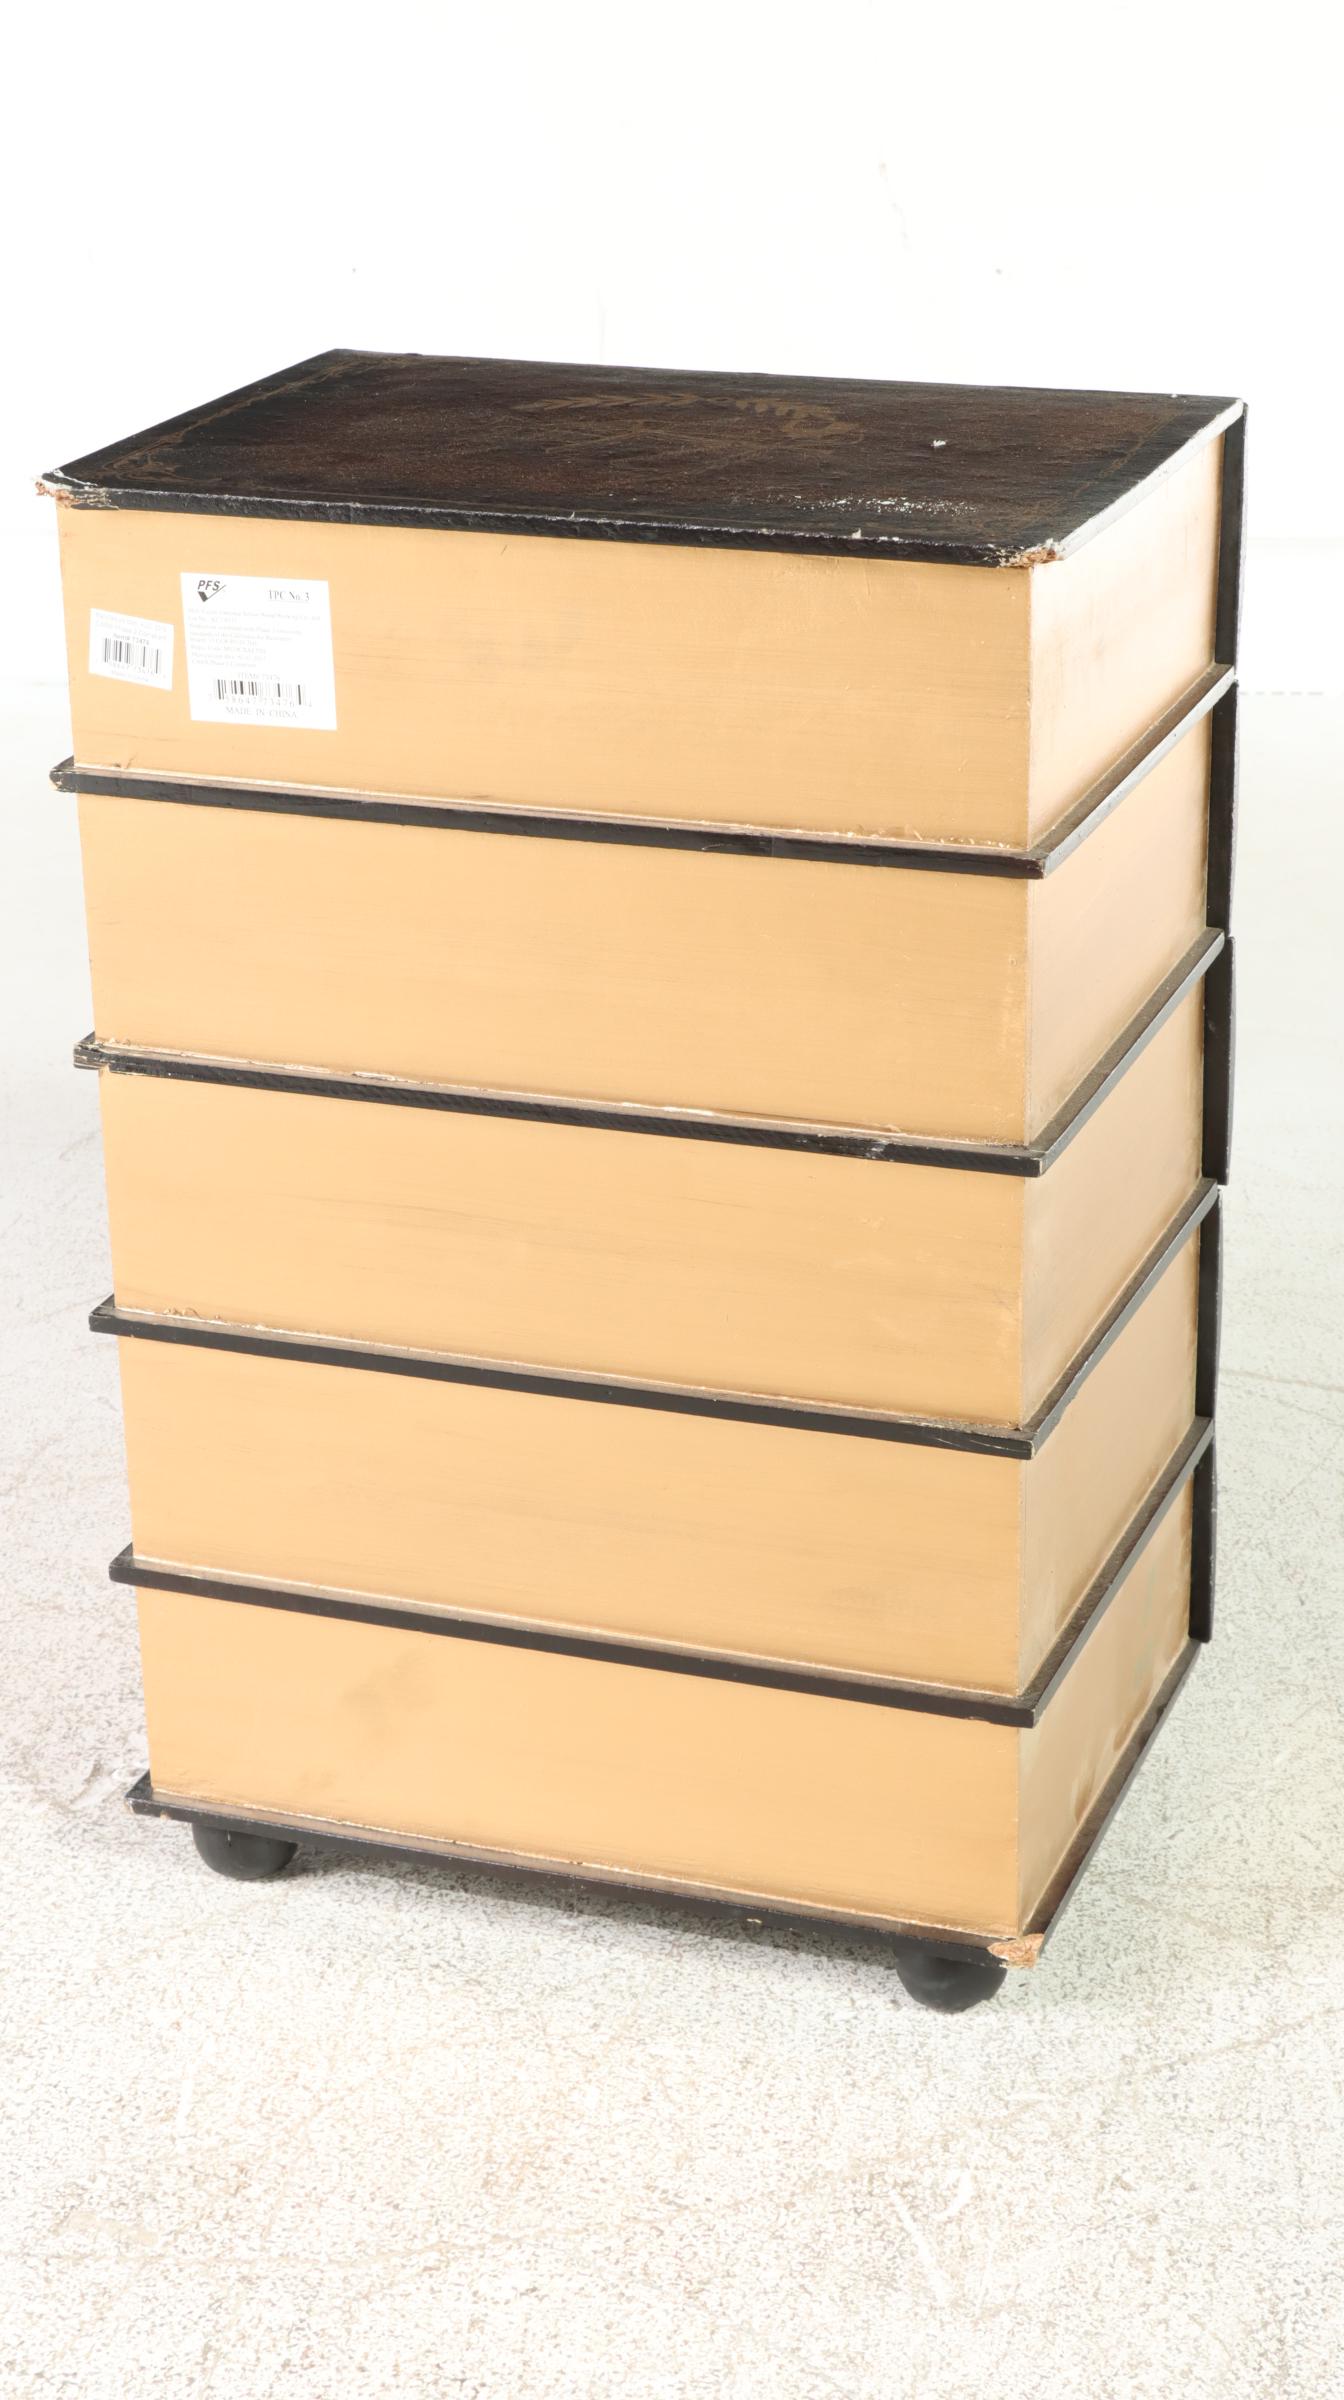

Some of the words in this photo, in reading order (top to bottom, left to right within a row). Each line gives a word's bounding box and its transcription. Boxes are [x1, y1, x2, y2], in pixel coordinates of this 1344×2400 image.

[197, 579, 221, 592] PFS
[288, 590, 302, 601] No.
[304, 591, 311, 602] 3
[226, 705, 252, 716] MADE
[255, 708, 266, 717] IN
[269, 708, 298, 719] CHINA
